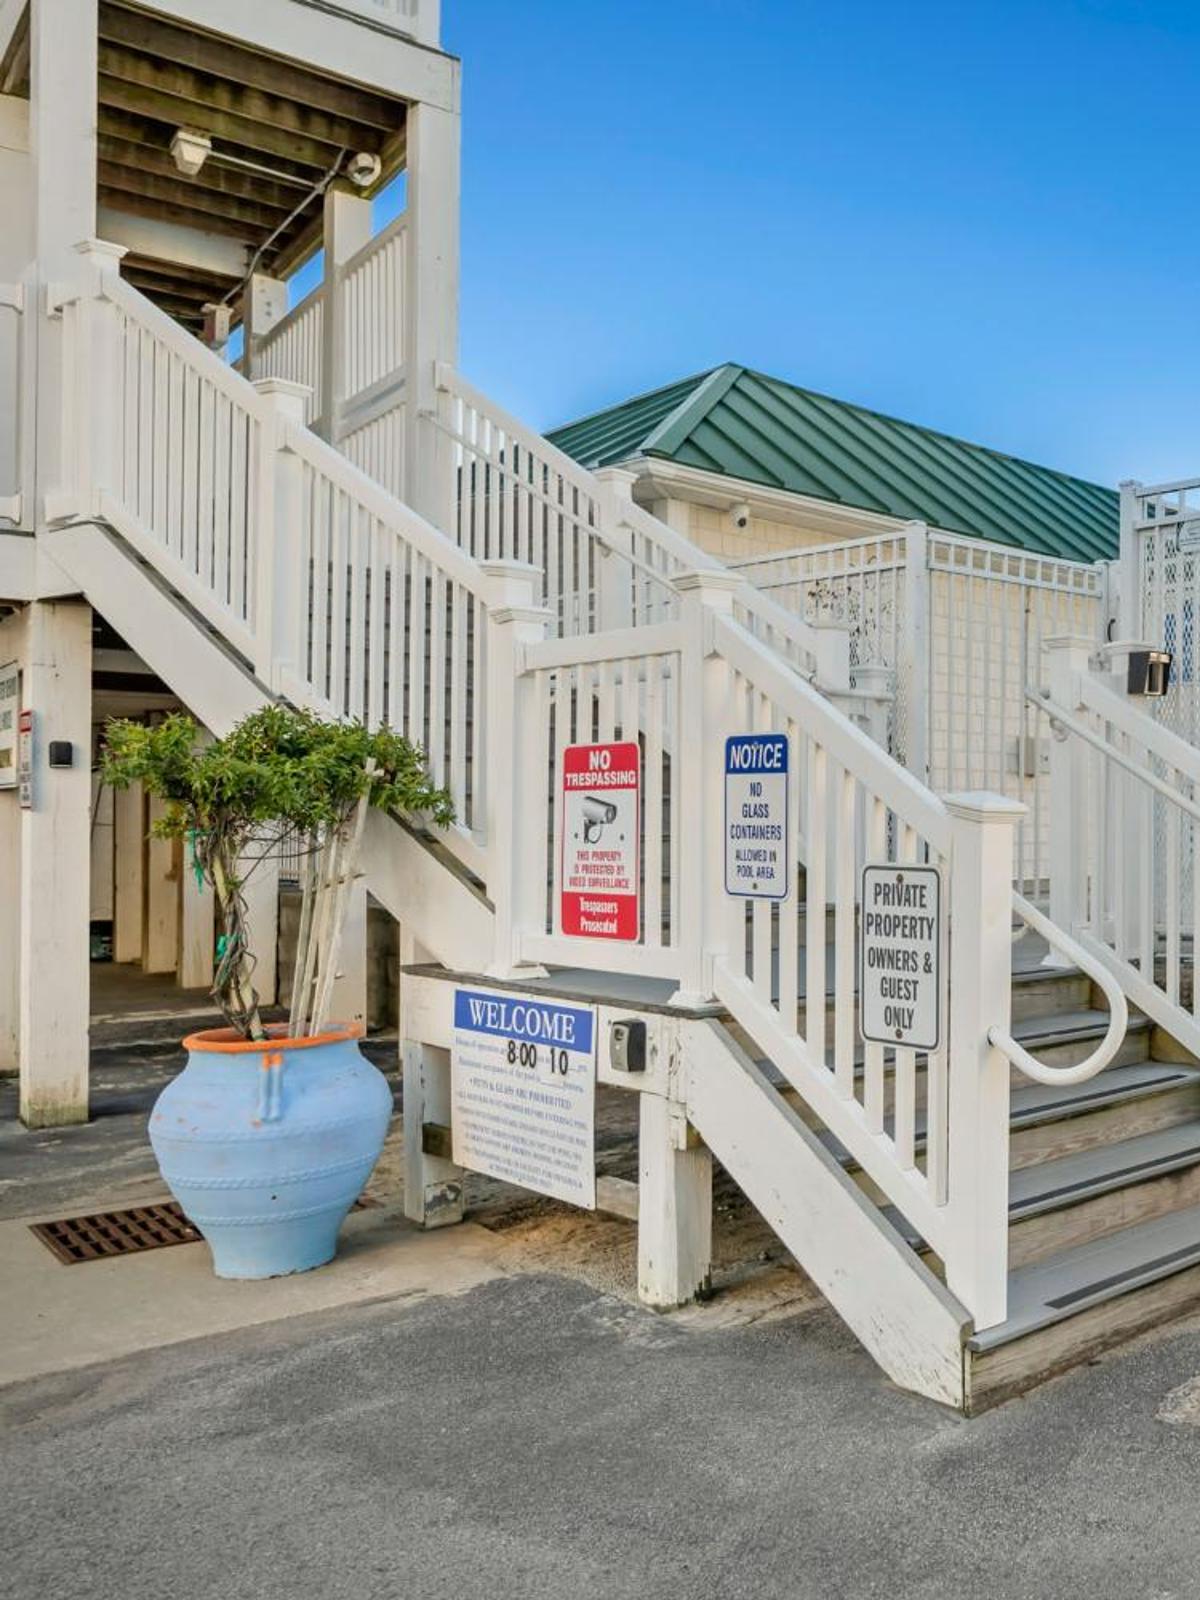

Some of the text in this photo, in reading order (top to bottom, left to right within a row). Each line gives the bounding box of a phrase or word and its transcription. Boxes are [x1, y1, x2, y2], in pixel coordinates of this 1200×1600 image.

[589, 750, 612, 771] NO
[730, 743, 783, 769] NOTICE
[566, 770, 636, 787] TRESPASSING
[750, 782, 763, 797] NO
[742, 803, 769, 818] GLASS
[730, 824, 782, 841] CONTAINERS
[735, 848, 777, 862] ALLOWED IN
[736, 865, 776, 879] POOL AREA
[579, 896, 618, 915] Trespassers
[874, 882, 927, 908] PRIVATE
[866, 912, 935, 940] PROPERTY
[868, 946, 933, 974] OWNERS &
[881, 976, 919, 1002] GUEST
[468, 998, 576, 1044] WELCOME
[884, 1005, 914, 1030] ONLY
